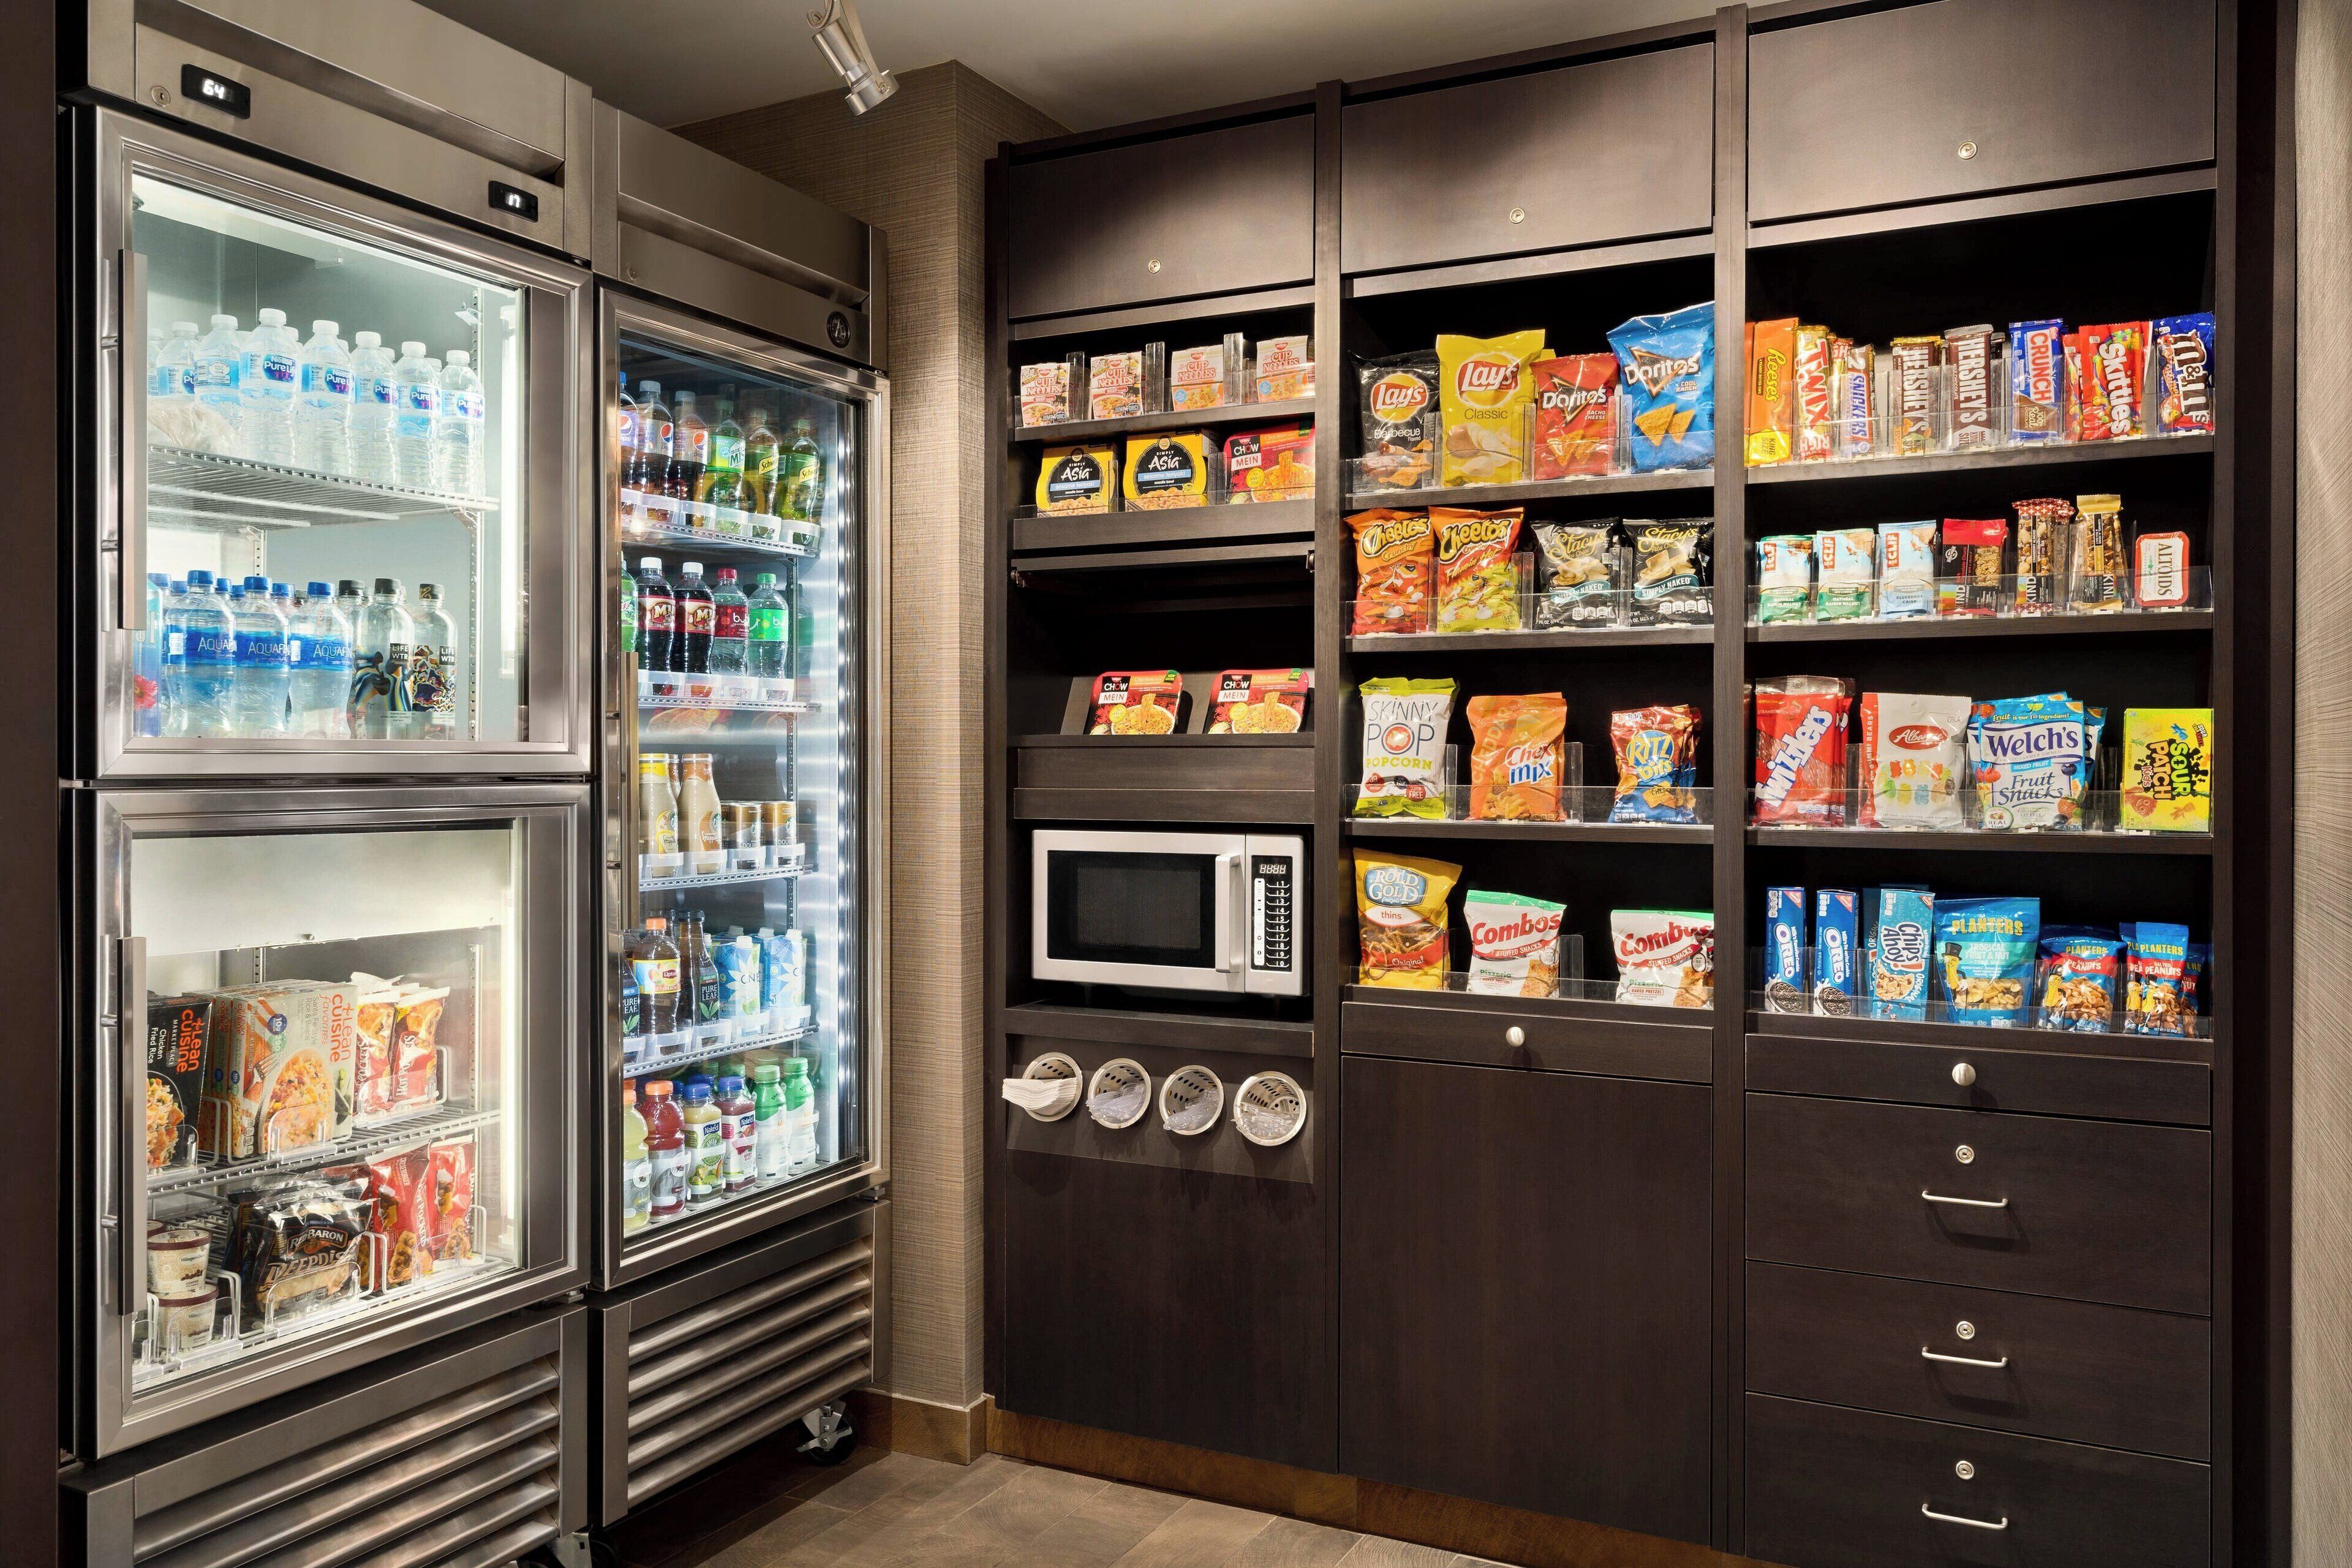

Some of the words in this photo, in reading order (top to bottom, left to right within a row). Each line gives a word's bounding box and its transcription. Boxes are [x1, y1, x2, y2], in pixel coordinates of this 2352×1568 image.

[203, 78, 225, 99] 64
[1186, 360, 1208, 371] CUP
[1262, 358, 1300, 374] NOODLES
[1271, 350, 1292, 362] CUP
[264, 361, 286, 372] Pure
[1106, 368, 1127, 379] CUP
[1178, 369, 1216, 382] NOODLES
[1624, 357, 1700, 385] Doritos
[1765, 348, 1787, 403] Reese's
[2030, 333, 2051, 401] CRUNCH
[326, 374, 346, 384] Pure
[1035, 377, 1054, 387] CUP
[1098, 375, 1134, 388] NOODLES
[1461, 363, 1519, 392] Lay's
[1959, 337, 1988, 423] HERSHEY'S
[1027, 385, 1063, 396] NOODLES
[1376, 383, 1425, 410] Lay's
[1543, 387, 1607, 409] Doritos
[1903, 347, 1929, 432] HERSHEY'S
[2099, 342, 2134, 434] Skittles
[1464, 408, 1508, 420] Classic
[1374, 427, 1420, 439] Barbecue
[1234, 442, 1259, 456] CHOW
[1236, 456, 1259, 467] MEIN
[1363, 518, 1431, 556] Cheetos
[1439, 519, 1512, 563] Cheetos
[1550, 531, 1606, 560] Stacy's
[1638, 527, 1698, 552] Stacy's
[1887, 533, 1899, 559] CLIF
[1382, 540, 1416, 562] Crunchy
[1823, 538, 1835, 561] CLIF
[2158, 543, 2173, 597] ALTOIDS
[1580, 583, 1604, 594] NAKED
[1642, 586, 1665, 597] SIMPLY
[1667, 578, 1692, 589] NAKED
[2027, 576, 2037, 604] KIND
[198, 637, 237, 652] AQUAFIN
[247, 642, 290, 656] AQUAFIN
[313, 644, 352, 658] AQUAFIN
[1104, 681, 1128, 691] CHOW
[1224, 680, 1250, 690] CHOW
[1104, 693, 1125, 701] MEIN
[1224, 692, 1246, 700] MEIN
[1992, 714, 2011, 723] Fruit
[1367, 722, 1434, 756] POP
[2198, 724, 2207, 738] SOUR
[1628, 736, 1672, 766] RITZ
[1986, 726, 2079, 757] Welch's
[1366, 757, 1433, 771] POPCORN
[1506, 745, 1553, 766] Chex
[1755, 705, 1833, 808] Twizzlers
[1510, 761, 1551, 784] mix
[1637, 759, 1673, 781] bits
[2141, 766, 2154, 788] Kids
[2150, 741, 2172, 800] PATCH
[2170, 742, 2191, 797] SOUR
[2011, 772, 2056, 790] Fruit
[1409, 791, 1423, 799] FREE
[1998, 785, 2064, 806] Snacks
[1374, 870, 1420, 886] ROLD
[1368, 883, 1419, 902] GOLD
[1381, 911, 1402, 919] thins
[1472, 913, 1561, 946] Combos
[1952, 918, 2023, 936] PLANTERS
[1520, 941, 1542, 954] SNACKS
[1774, 922, 1795, 979] OREO
[1898, 922, 1923, 966] Chips
[2066, 946, 2108, 955] PLANTERS
[2140, 944, 2184, 956] PLANTERS
[1392, 955, 1425, 967] Original
[1648, 958, 1672, 967] STUFFED
[1673, 946, 1693, 962] SNACKS
[1823, 927, 1844, 984] OREO
[1995, 951, 2010, 960] NUT
[1480, 969, 1512, 978] Pizzeria
[2144, 965, 2182, 976] PEANUTS
[702, 984, 718, 993] PURE
[1905, 973, 1925, 1003] ORIGINAL
[318, 993, 331, 1045] favorites
[330, 993, 343, 1063] cuisine
[150, 1027, 159, 1047] Fried
[157, 1029, 167, 1060] Chicken
[168, 1019, 178, 1067] MARKETPLACE
[176, 1009, 194, 1073] cuisine
[341, 1017, 353, 1061] Lean
[148, 1047, 156, 1064] Rice
[188, 1028, 202, 1071] Lean
[290, 1233, 307, 1249] RED
[307, 1229, 344, 1242] BARON
